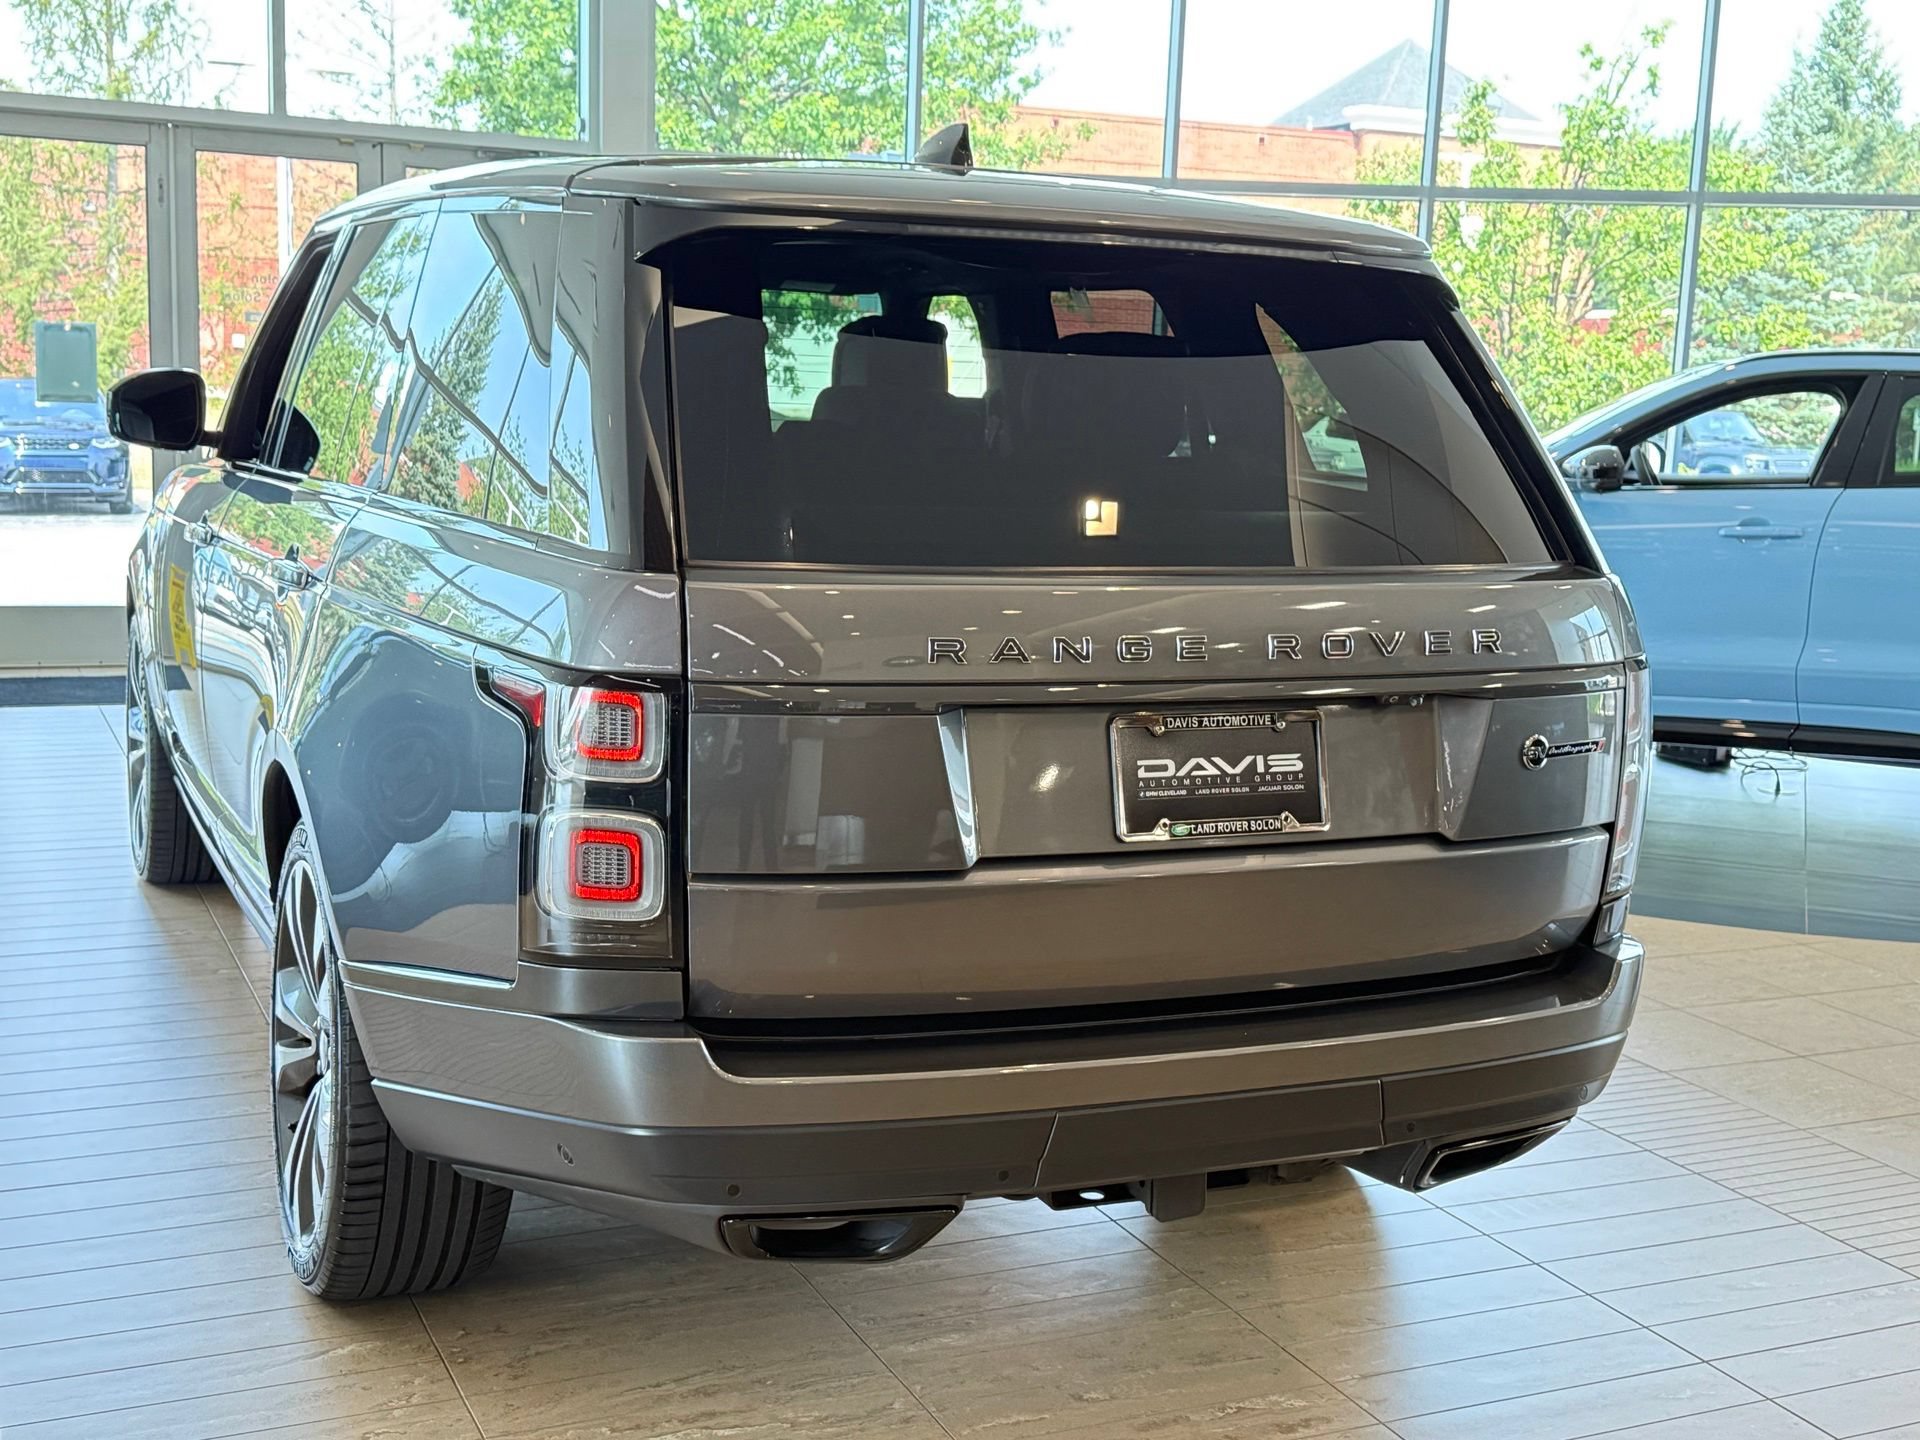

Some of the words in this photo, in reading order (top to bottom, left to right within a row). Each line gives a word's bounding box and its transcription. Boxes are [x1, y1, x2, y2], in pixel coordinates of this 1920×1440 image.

[926, 634, 1209, 665] RANGE
[1266, 628, 1503, 660] ROVER
[1166, 716, 1199, 729] DAVIS
[1202, 714, 1272, 727] AUTOMOTIVE
[1136, 753, 1304, 779] DAVIS
[1139, 776, 1241, 788] AUTOMOTIVE
[1254, 773, 1304, 783] GROUP
[1257, 784, 1282, 792] JAGUAR
[1282, 783, 1304, 791] SOLON
[1158, 789, 1187, 797] CLEVELAND
[1191, 823, 1216, 834] LAND
[1217, 821, 1248, 833] ROVER
[1250, 818, 1281, 831] SOLON
